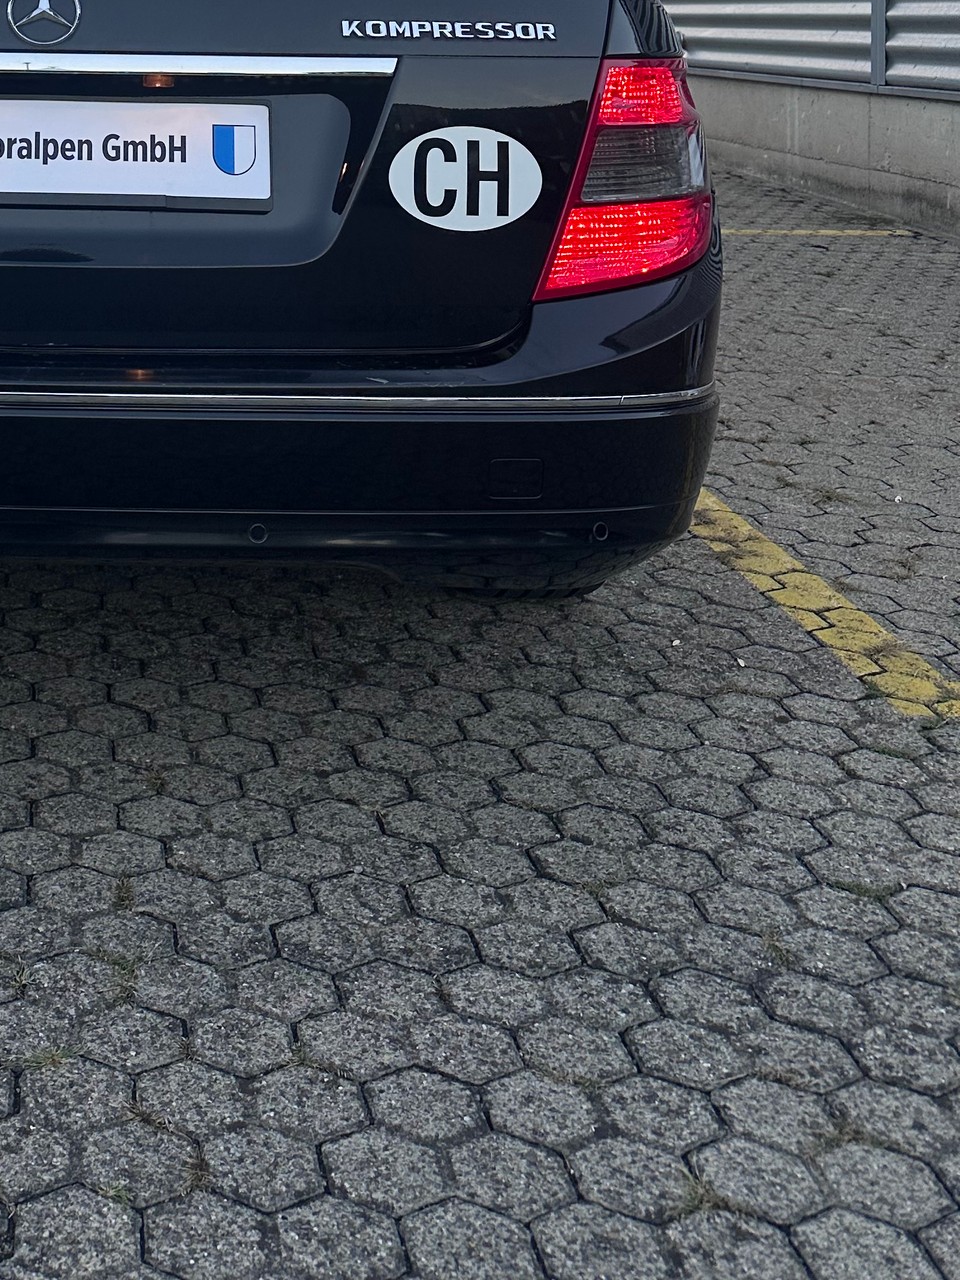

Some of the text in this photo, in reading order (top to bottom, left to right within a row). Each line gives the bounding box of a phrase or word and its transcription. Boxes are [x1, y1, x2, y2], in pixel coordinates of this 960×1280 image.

[341, 20, 556, 40] KOMPRESSOR
[102, 133, 187, 163] GmbH
[413, 137, 510, 218] CH
